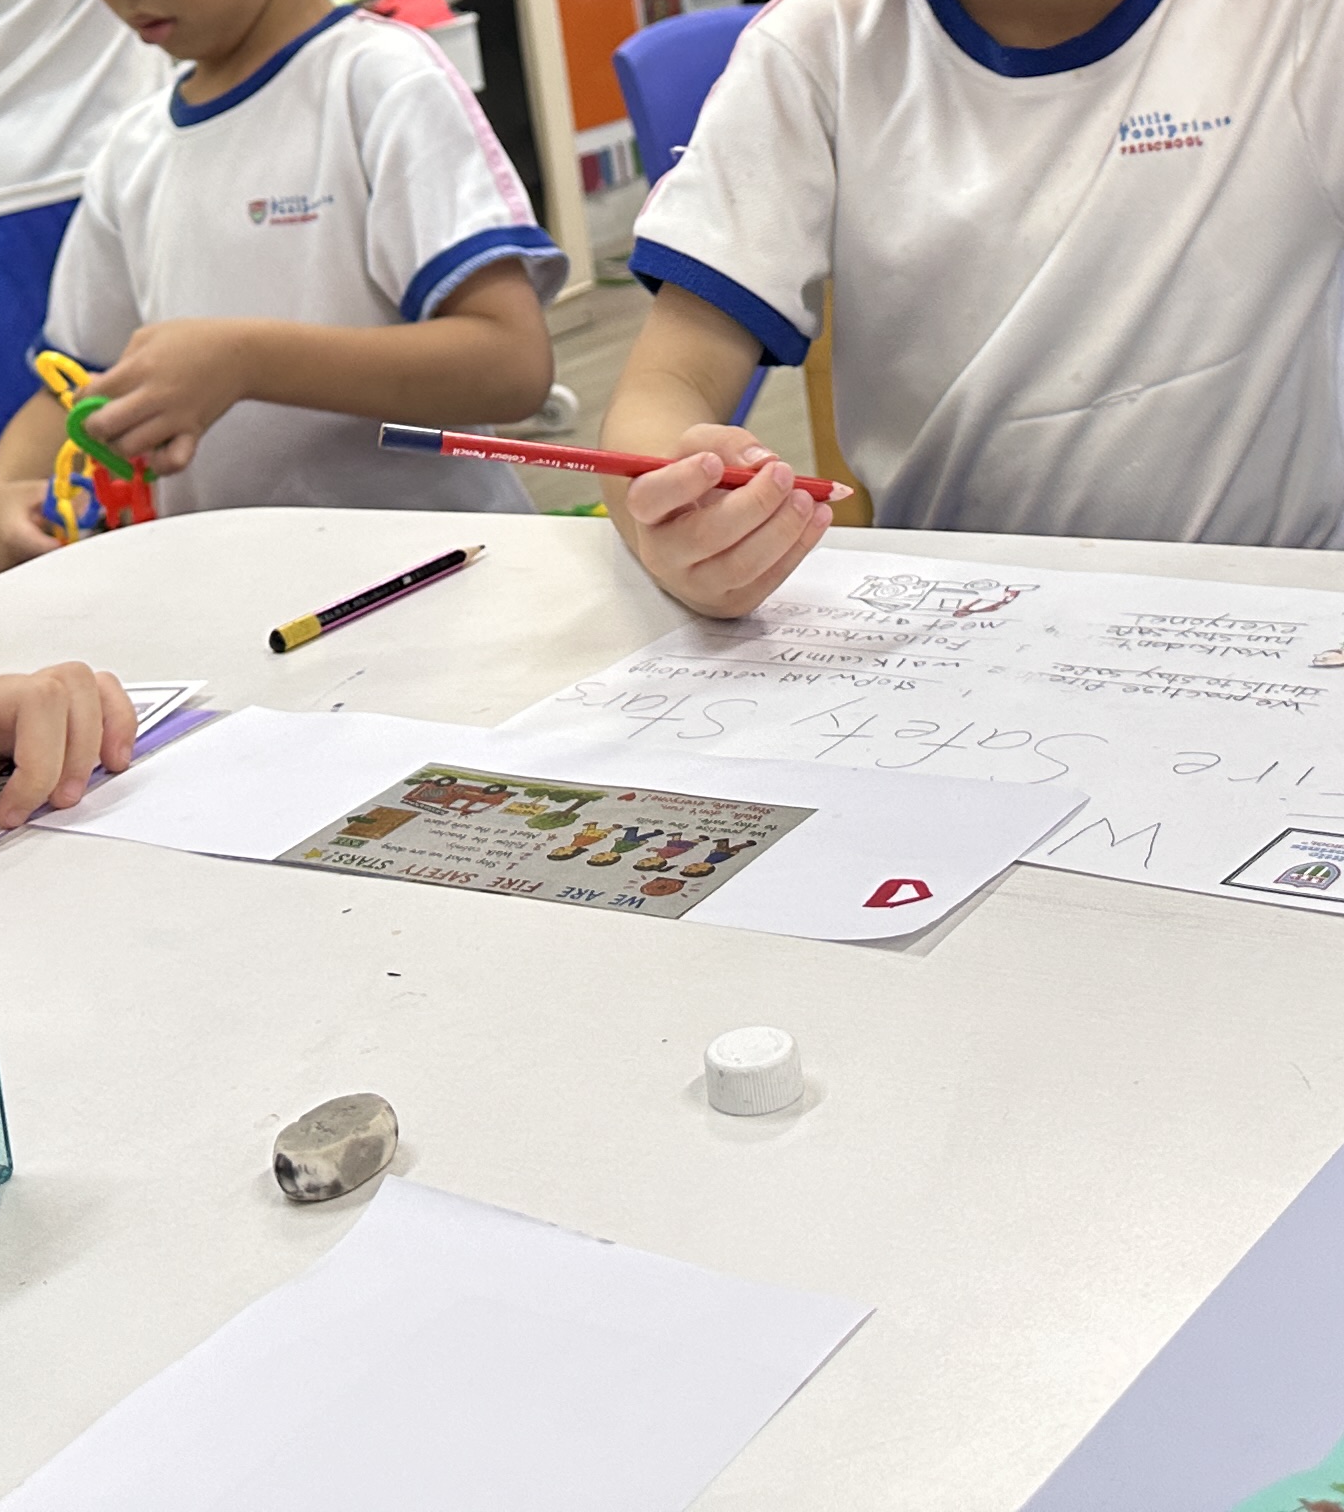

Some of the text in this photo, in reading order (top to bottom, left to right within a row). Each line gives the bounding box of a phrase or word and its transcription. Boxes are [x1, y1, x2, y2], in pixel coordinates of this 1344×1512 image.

[1120, 116, 1231, 142] Footprints
[452, 447, 487, 459] Pencil
[490, 453, 527, 464] Colour
[1138, 666, 1196, 685] stay
[1049, 675, 1106, 691] fire
[557, 681, 757, 739] Stars
[1256, 698, 1304, 715] We
[790, 696, 1108, 785] Safety
[474, 826, 492, 834] the
[470, 836, 489, 845] the
[493, 839, 529, 849] Follow
[408, 848, 427, 856] are
[428, 851, 443, 859] we
[484, 849, 513, 859] Walk
[444, 854, 472, 864] what
[475, 858, 499, 869] Stop
[323, 850, 646, 909] WE ARE FIRE SAFETY STARS!
